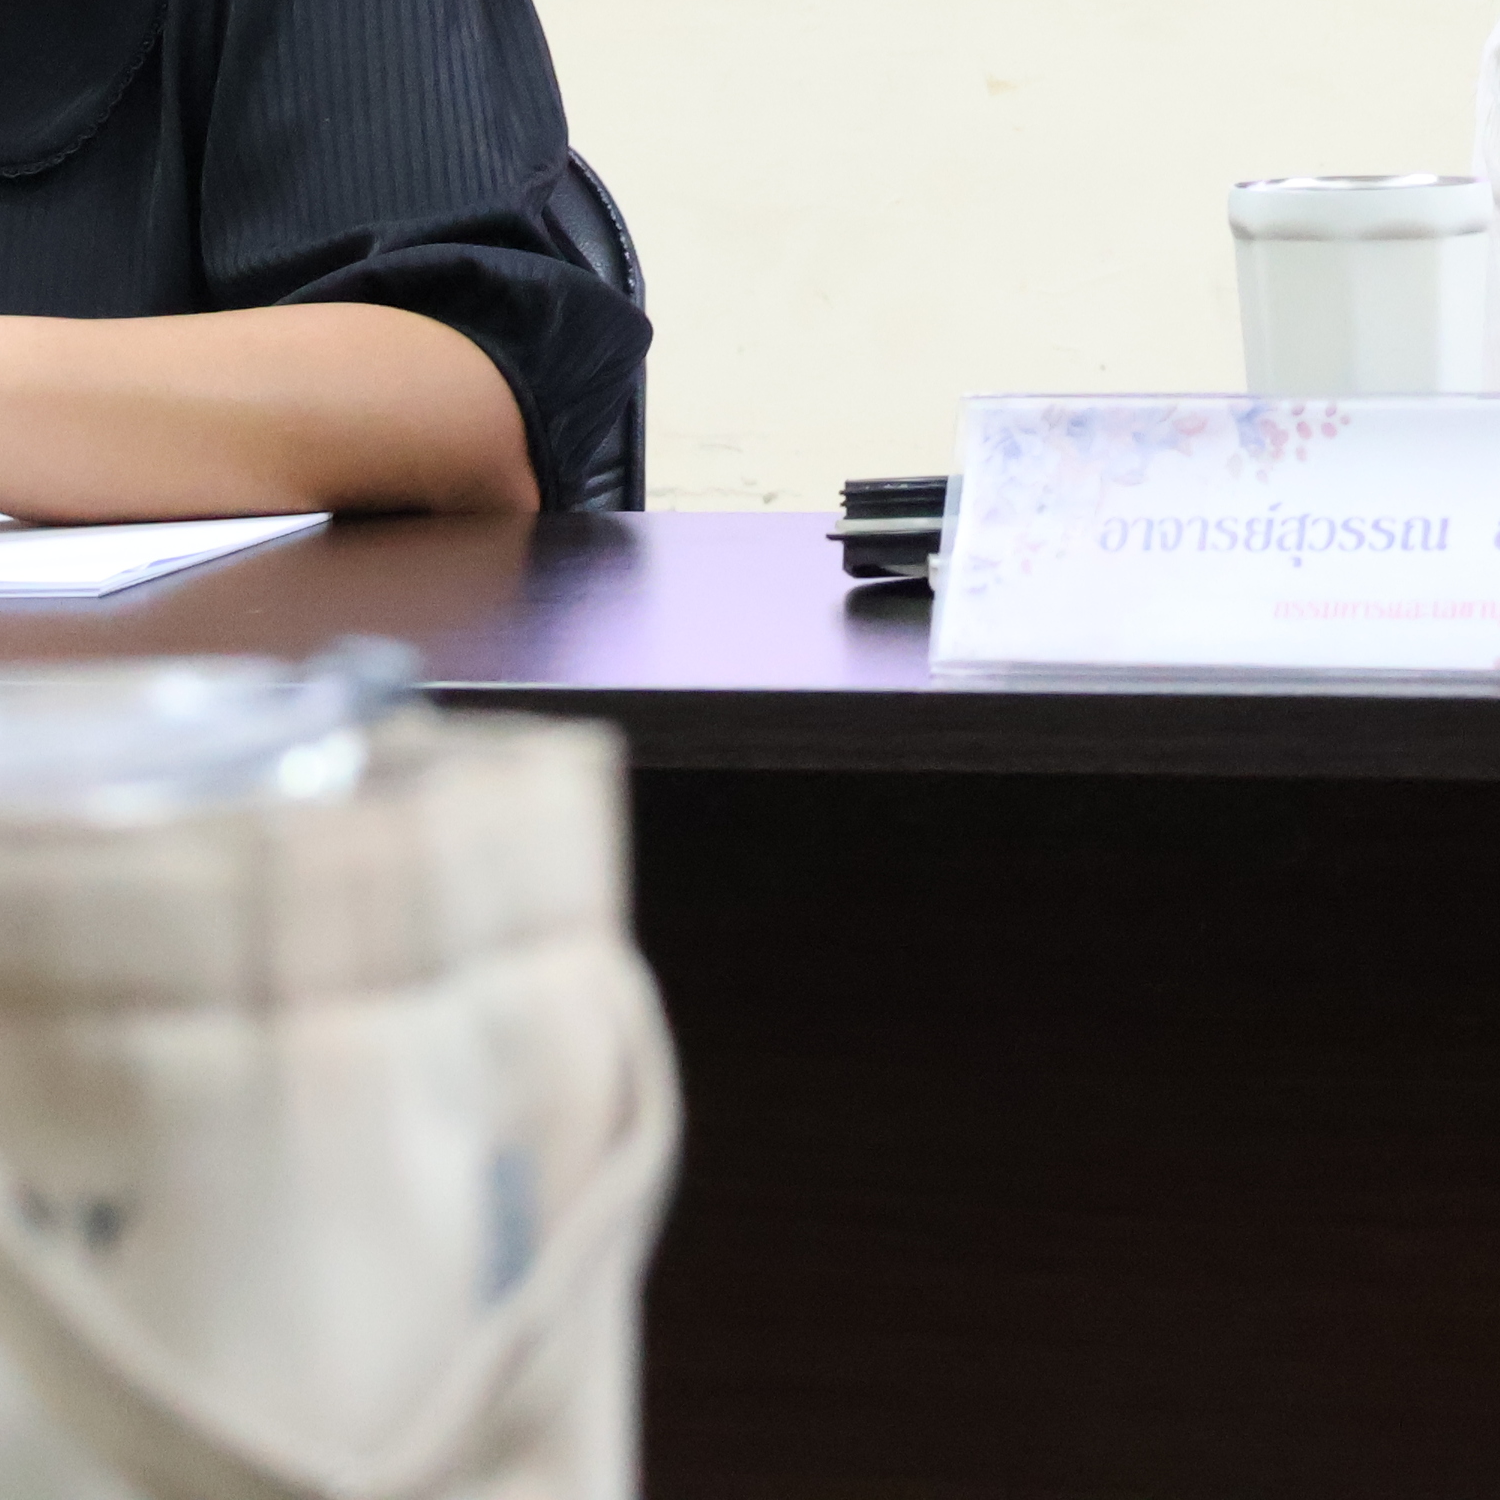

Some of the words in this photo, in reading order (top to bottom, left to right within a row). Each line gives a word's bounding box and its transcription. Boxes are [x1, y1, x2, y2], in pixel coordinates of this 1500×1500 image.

[1099, 501, 1450, 568] อาจารย์สุวรรณ
